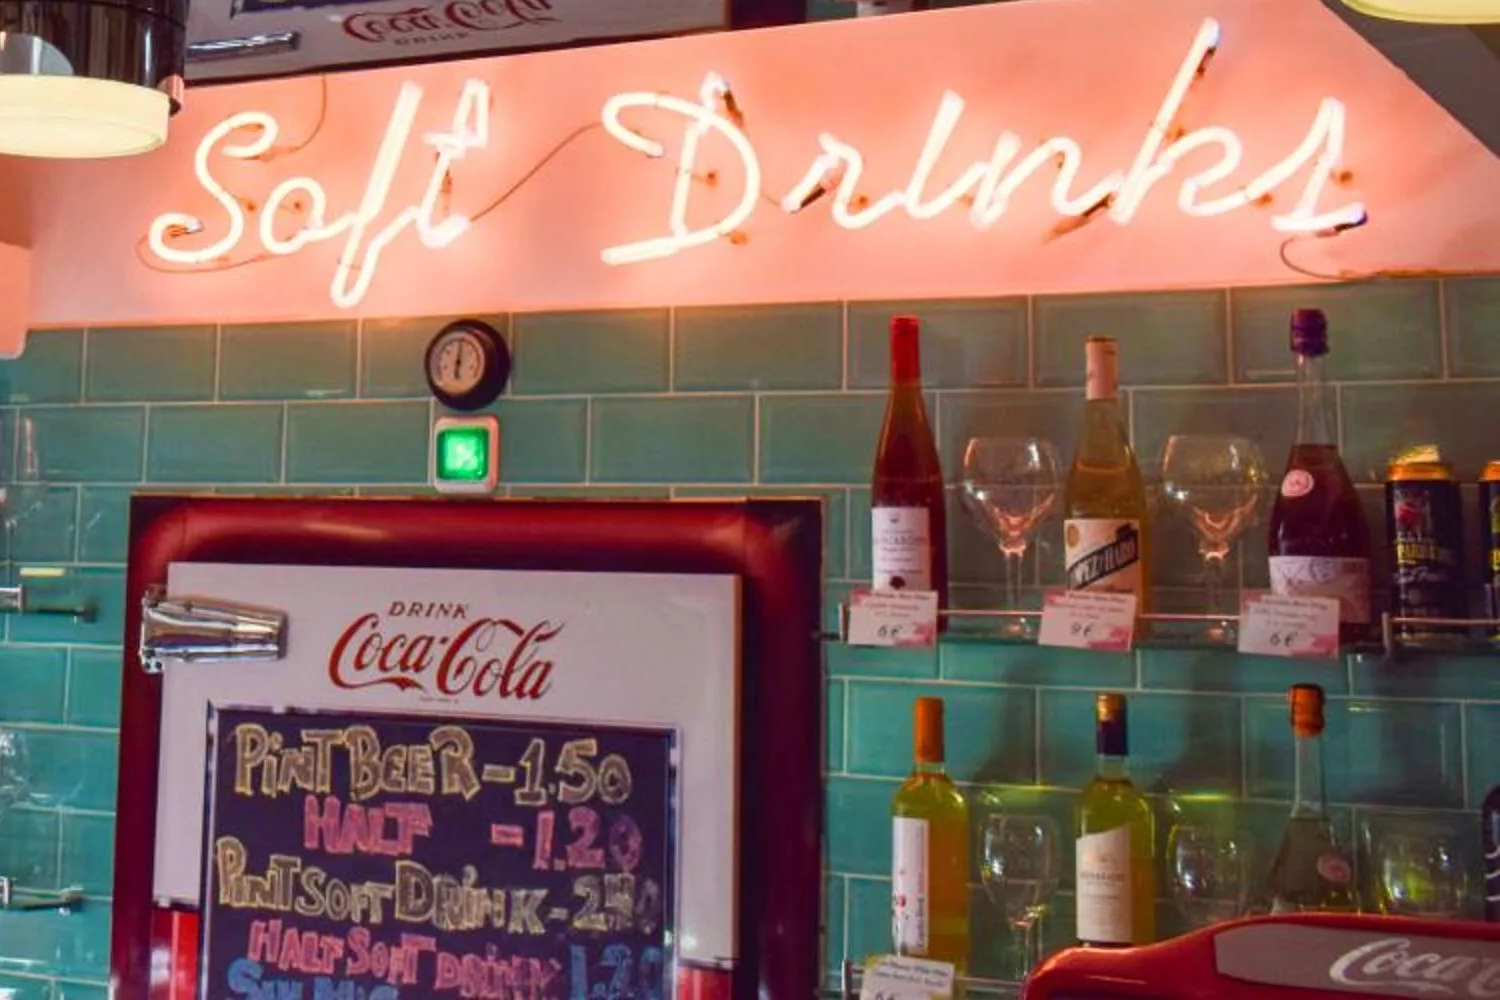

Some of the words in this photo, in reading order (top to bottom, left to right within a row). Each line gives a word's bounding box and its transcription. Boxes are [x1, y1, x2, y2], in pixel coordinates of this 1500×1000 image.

[150, 78, 490, 307] Soft
[602, 17, 1366, 267] Drinks
[388, 601, 469, 619] DRINK
[328, 612, 565, 700] Coca-Cola
